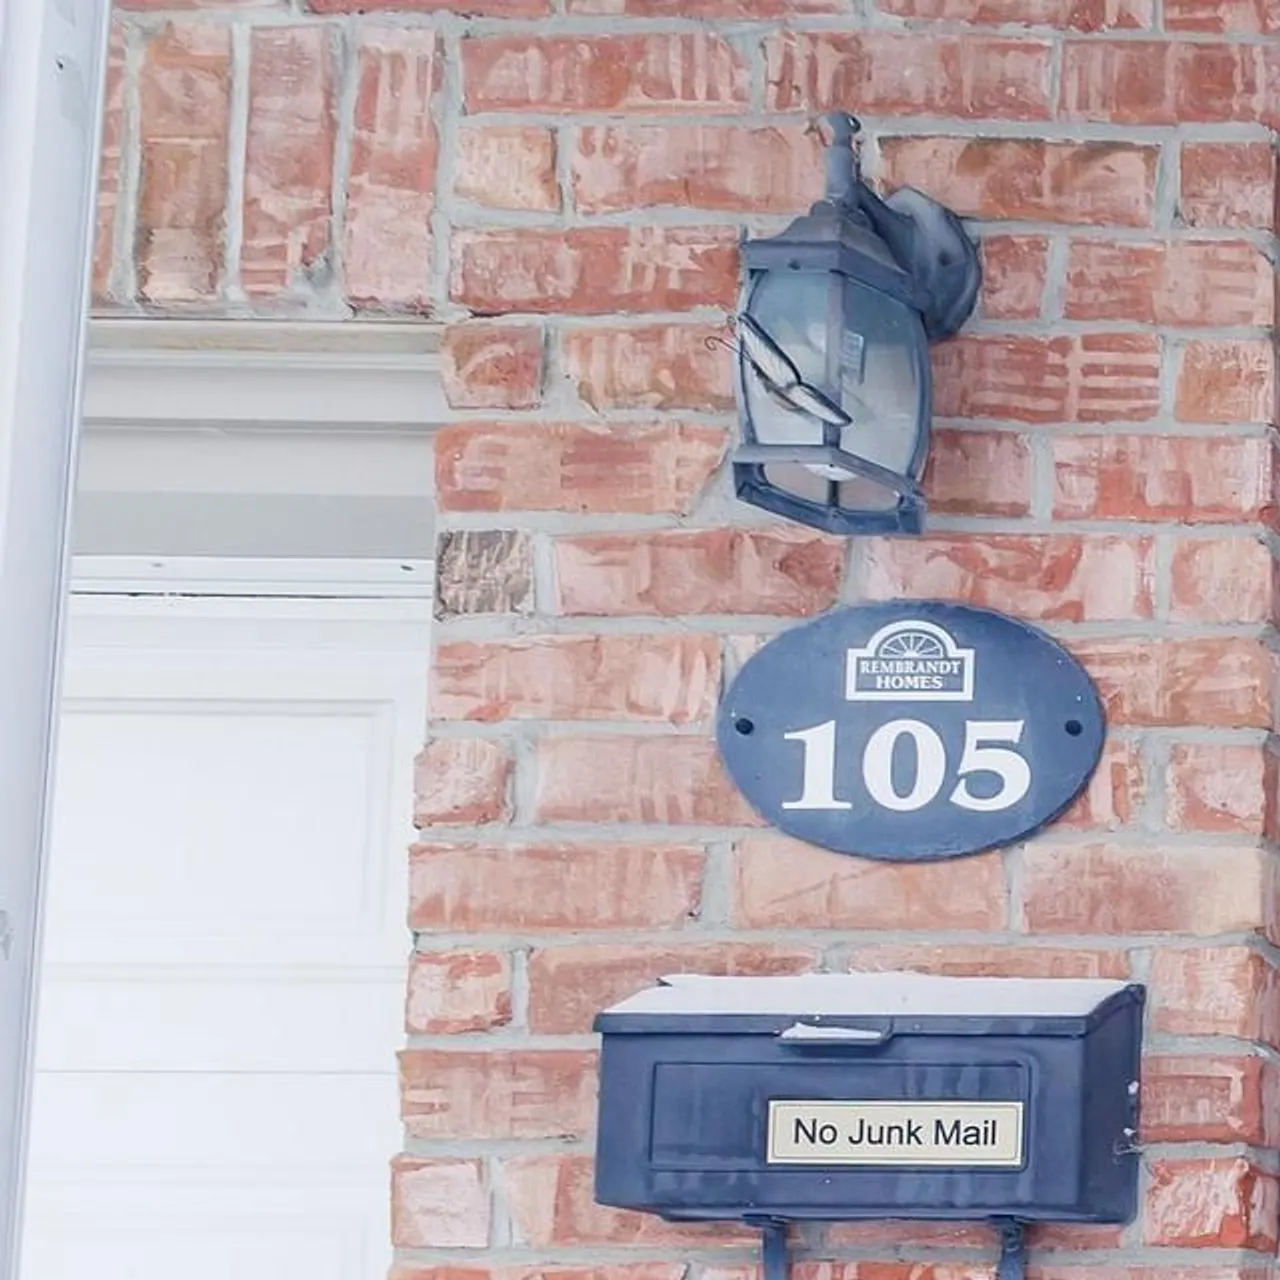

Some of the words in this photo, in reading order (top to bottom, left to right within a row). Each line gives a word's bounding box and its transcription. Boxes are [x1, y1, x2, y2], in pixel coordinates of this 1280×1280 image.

[859, 660, 962, 674] REMBRANDT
[875, 675, 944, 689] HOMES
[781, 719, 1032, 811] 105
[793, 1118, 838, 1145] No
[848, 1118, 923, 1146] Junk
[933, 1118, 998, 1146] Mail
